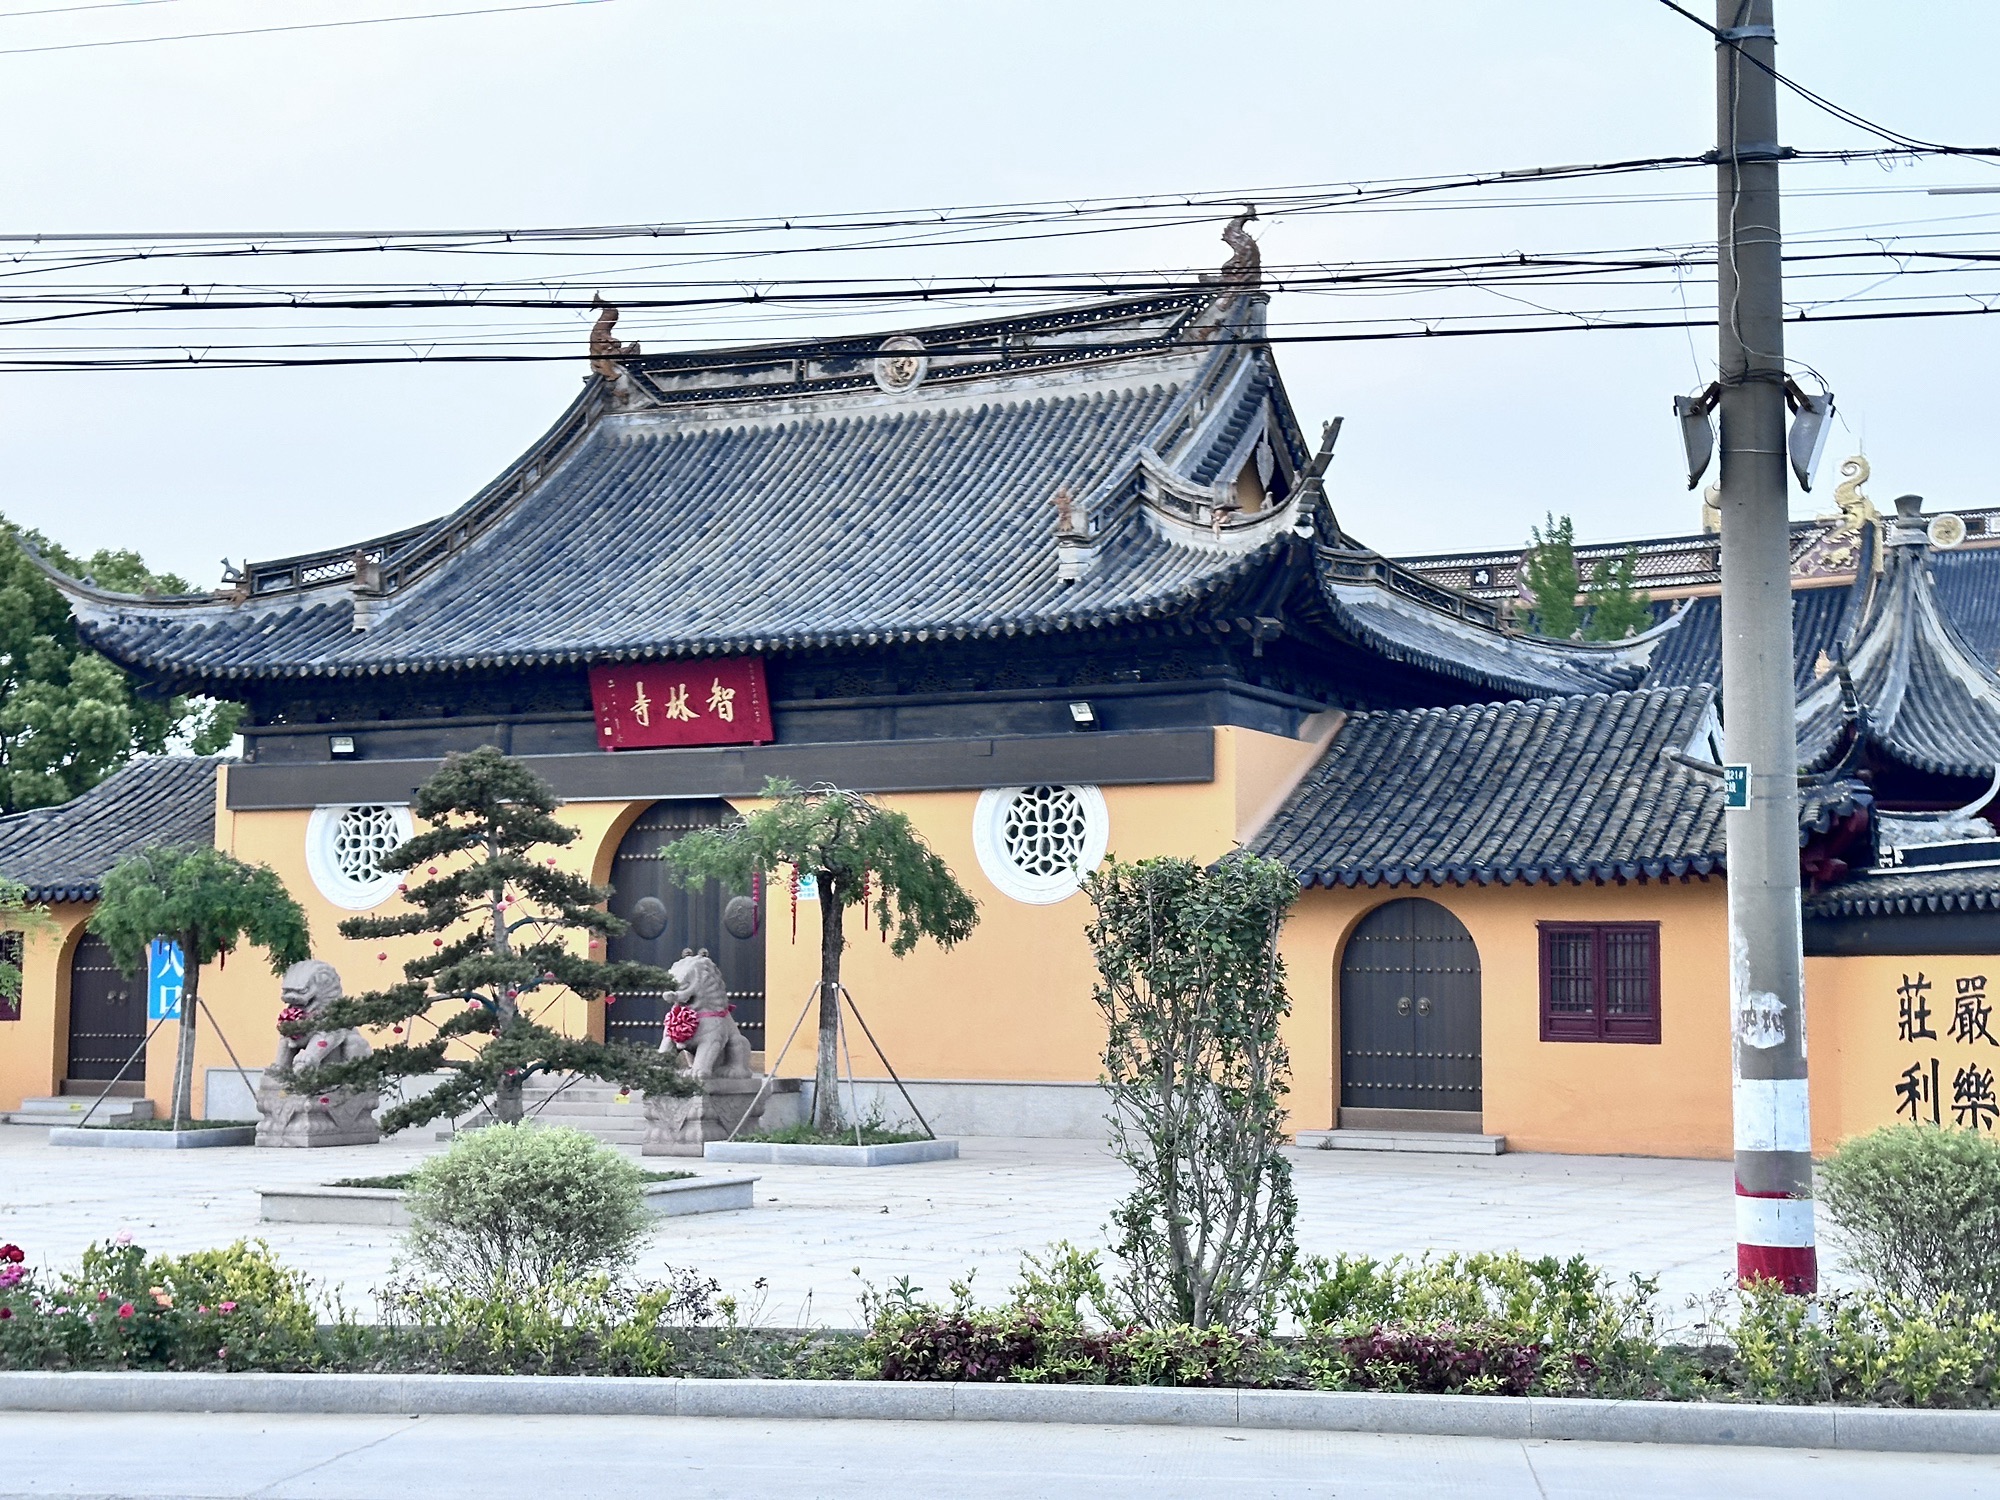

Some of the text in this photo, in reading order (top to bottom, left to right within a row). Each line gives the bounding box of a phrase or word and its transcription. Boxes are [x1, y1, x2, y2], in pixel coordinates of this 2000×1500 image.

[630, 677, 737, 727] 智林寺
[157, 944, 184, 1014] 入口
